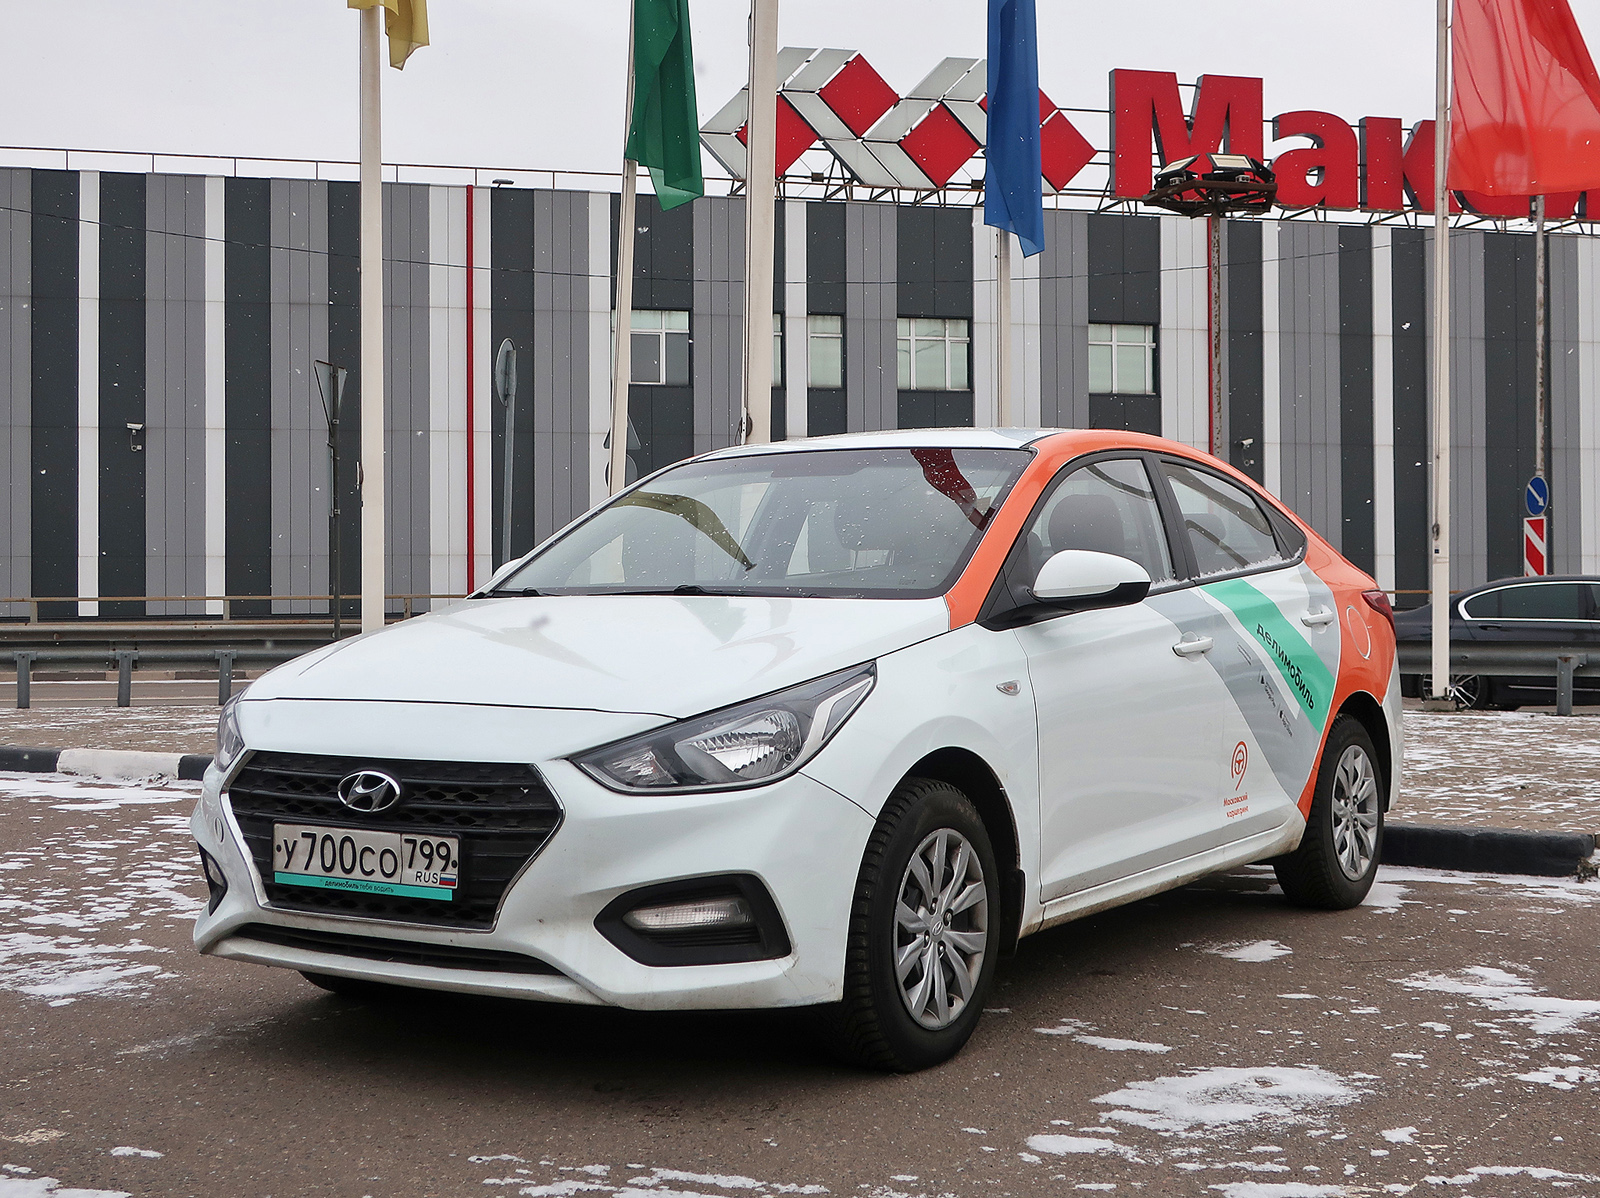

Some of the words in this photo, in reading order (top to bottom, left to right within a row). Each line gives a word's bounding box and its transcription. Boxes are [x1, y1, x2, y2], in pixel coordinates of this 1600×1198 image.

[1256, 623, 1315, 710] делимобиль
[404, 838, 452, 872] 799
[324, 880, 359, 890] делимобиль
[415, 871, 438, 884] RUS
